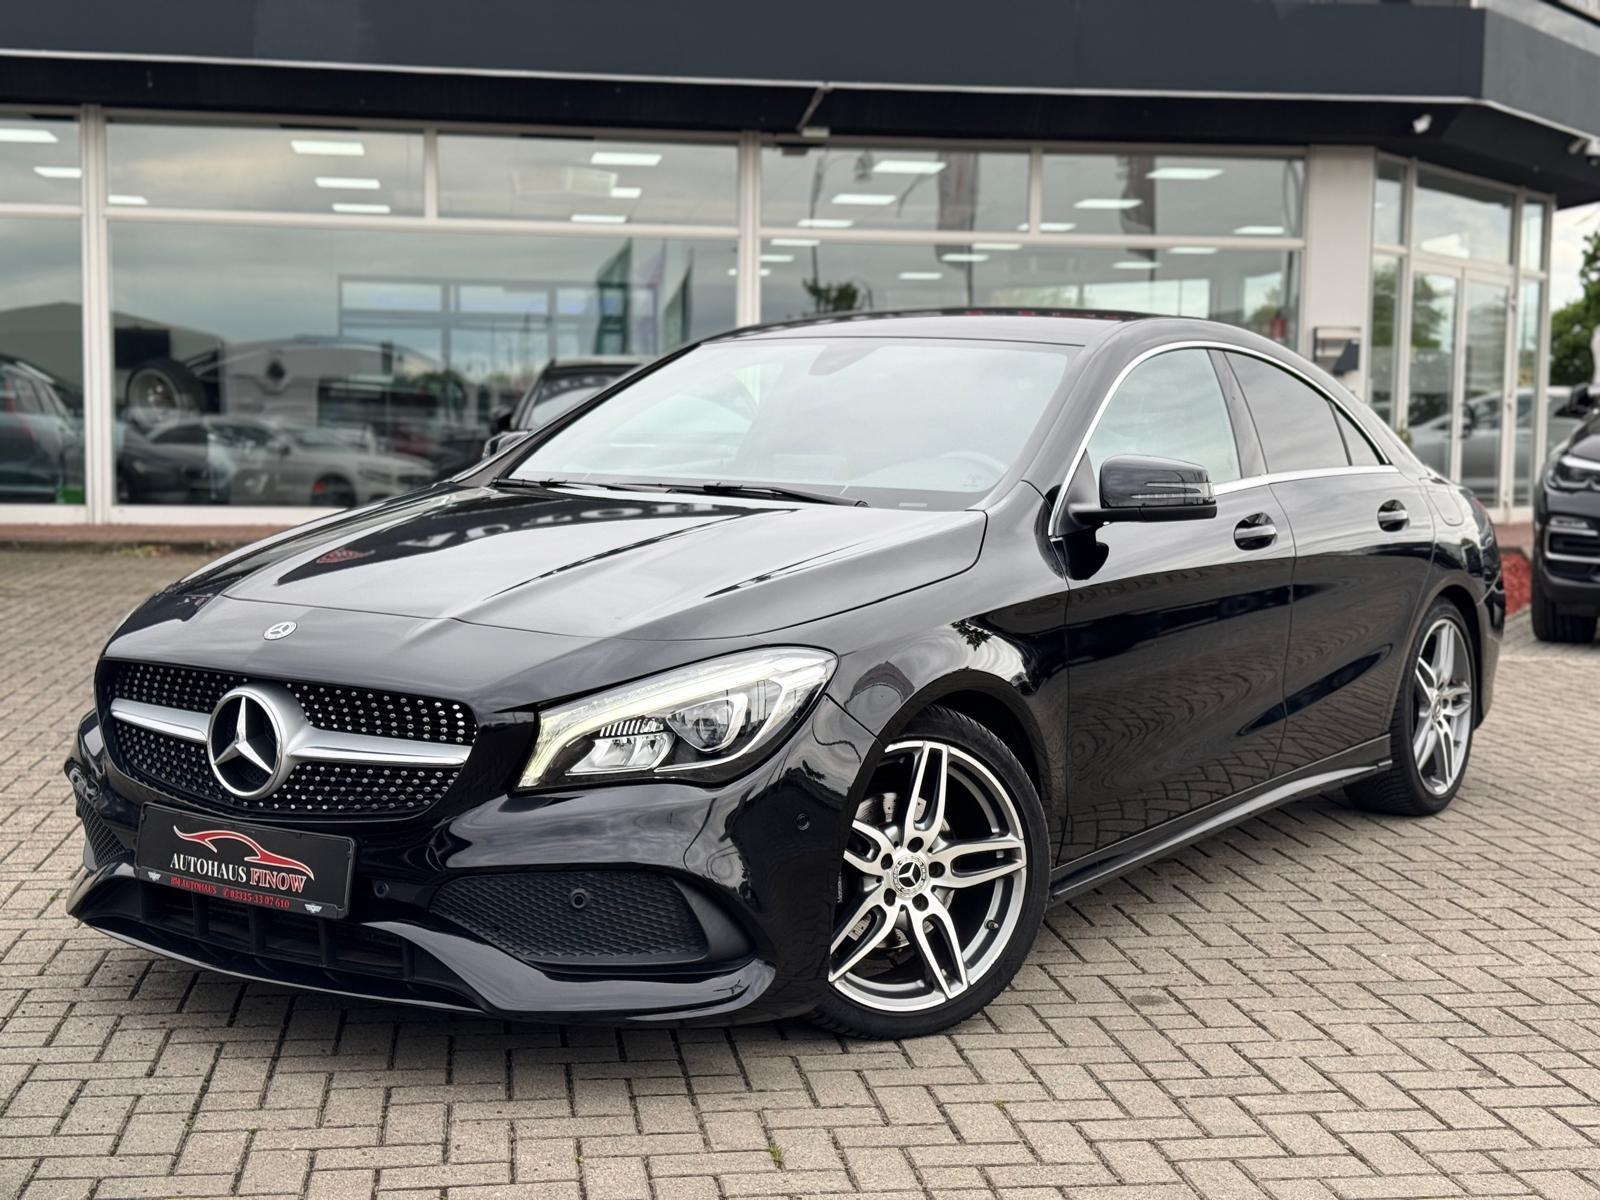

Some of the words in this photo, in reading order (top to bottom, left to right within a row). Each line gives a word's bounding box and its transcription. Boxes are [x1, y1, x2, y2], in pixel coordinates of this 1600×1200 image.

[170, 853, 246, 882] AUTOHAUS
[250, 868, 306, 892] FINOW
[181, 880, 216, 895] AUTOHAUS
